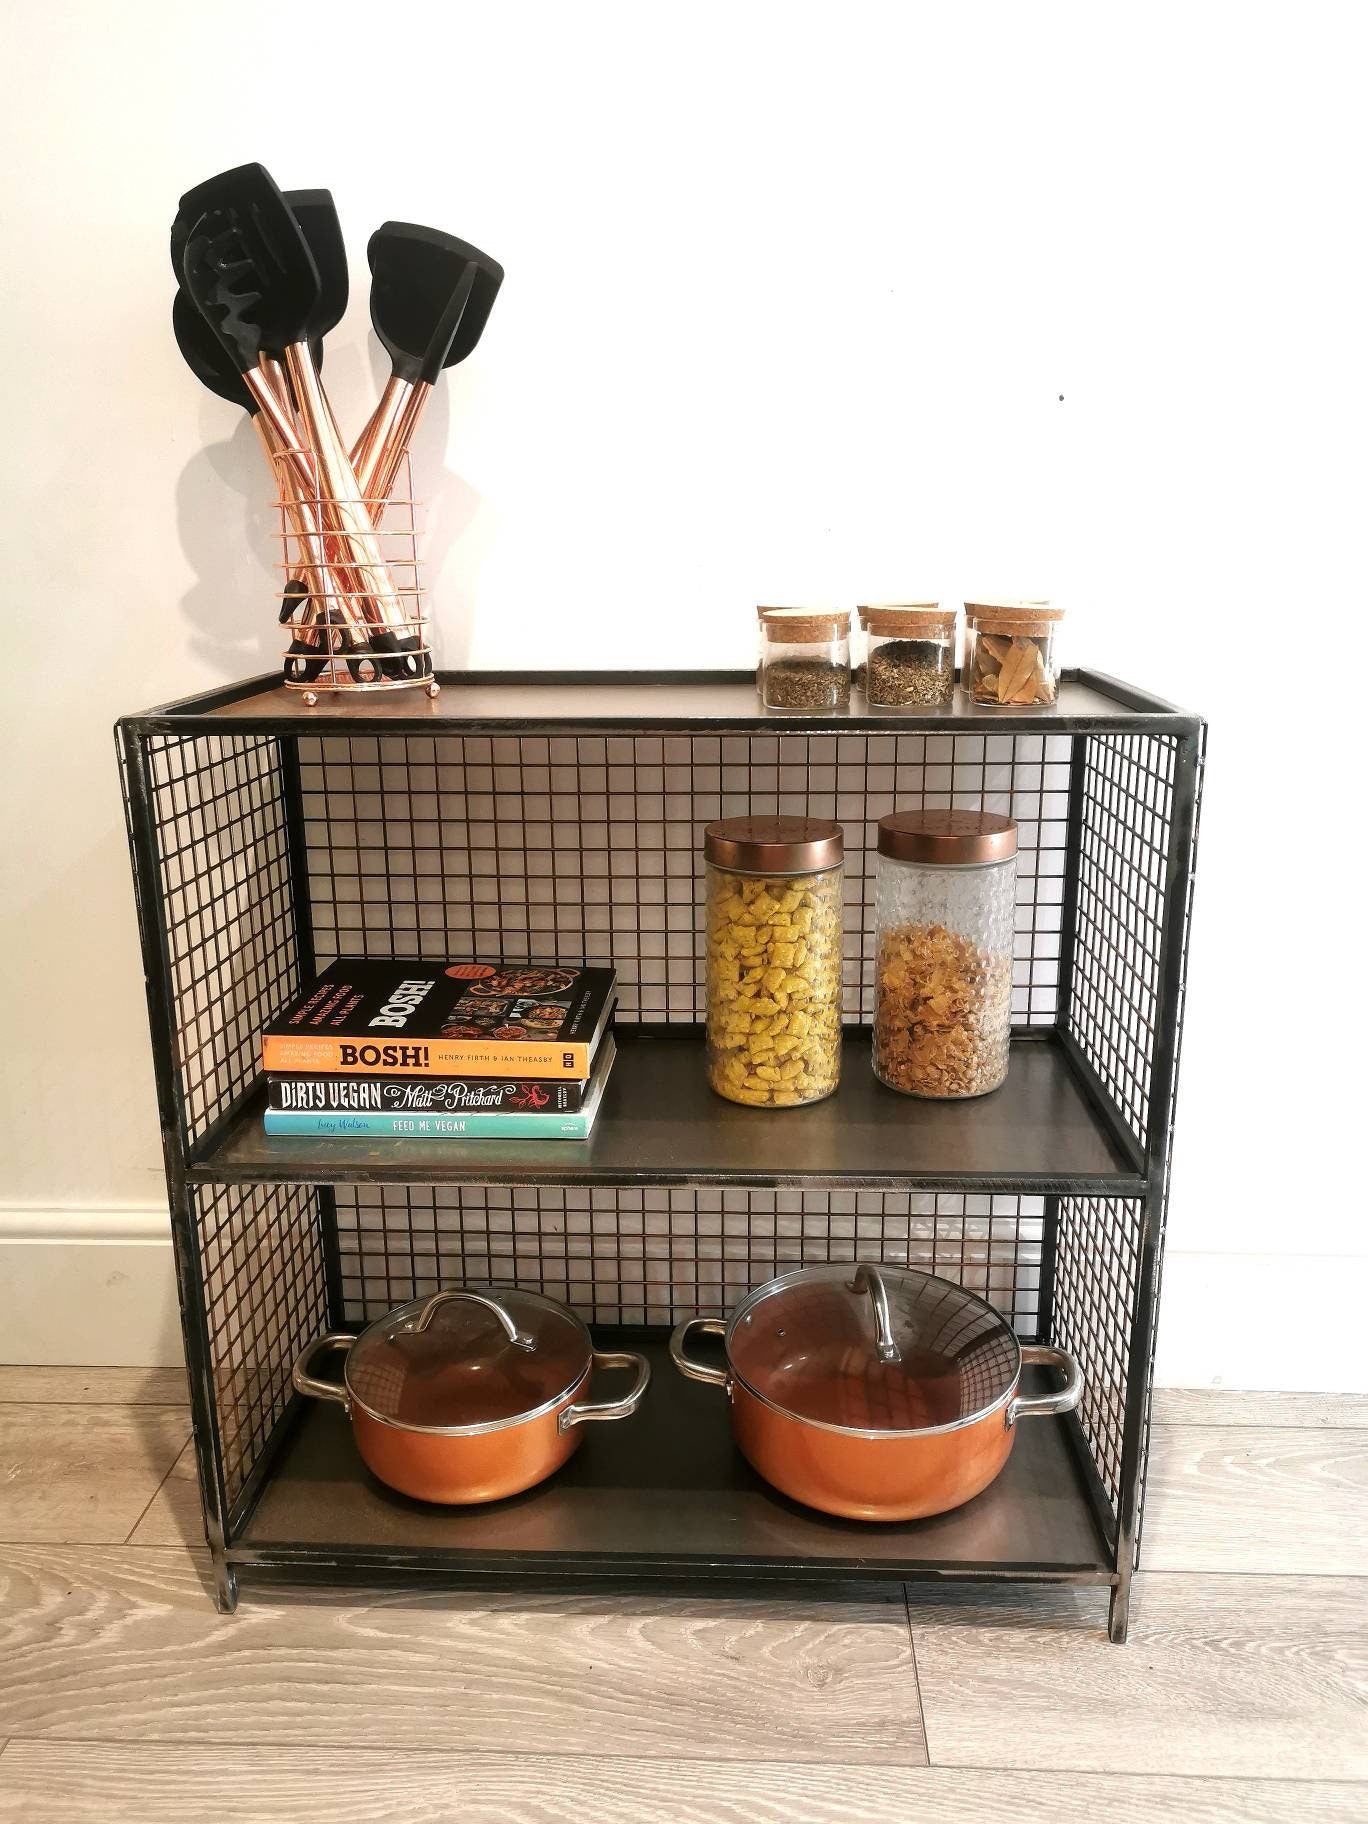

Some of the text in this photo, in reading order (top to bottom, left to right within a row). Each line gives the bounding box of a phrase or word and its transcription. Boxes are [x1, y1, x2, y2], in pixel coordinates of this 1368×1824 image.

[368, 980, 435, 1028] BOSH!
[340, 1044, 429, 1067] BOSH!
[467, 1054, 490, 1062] FIRTH
[328, 1082, 382, 1109] VEGAN
[384, 1082, 517, 1110] Matt Pritchard
[339, 1117, 370, 1130] Watson
[393, 1120, 466, 1132] FEED ME VEGAN
